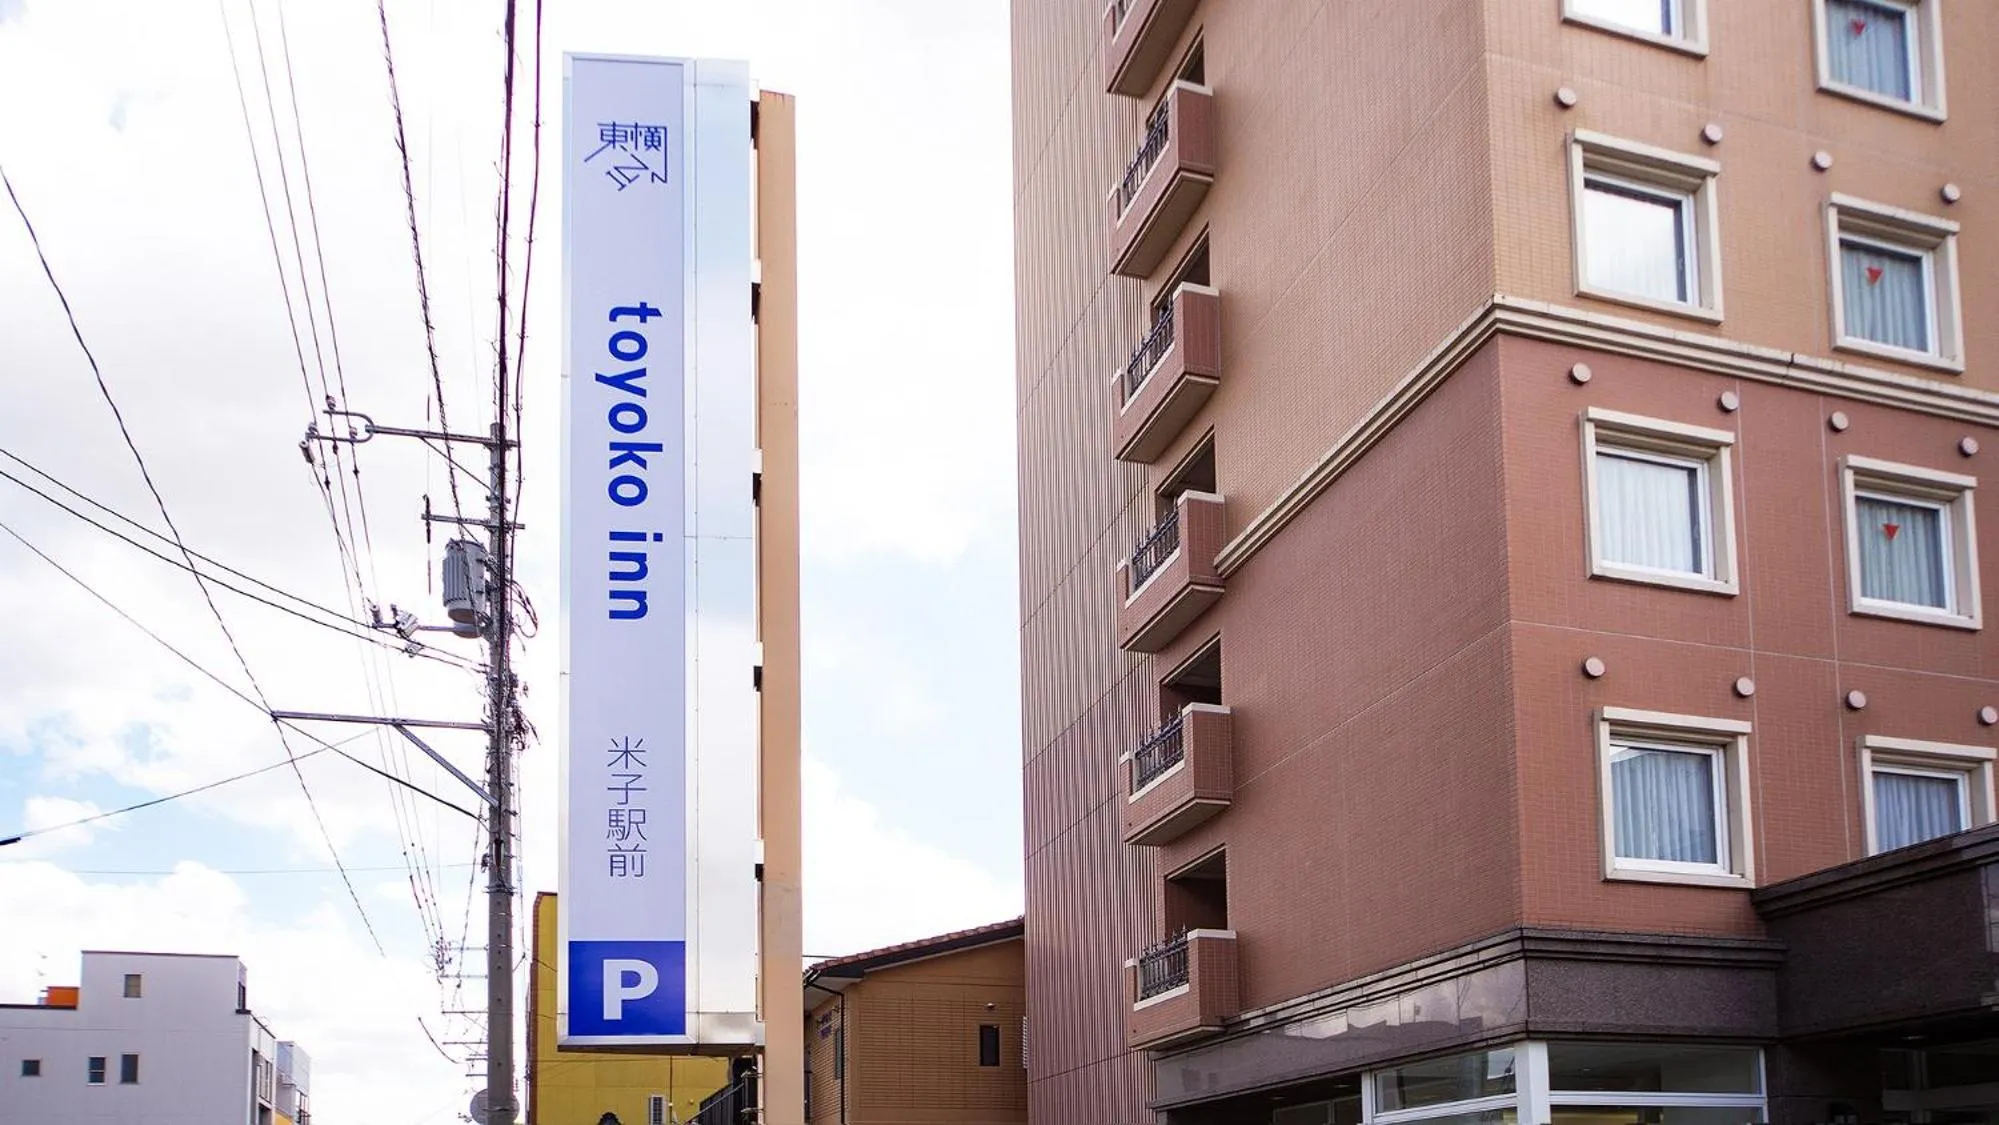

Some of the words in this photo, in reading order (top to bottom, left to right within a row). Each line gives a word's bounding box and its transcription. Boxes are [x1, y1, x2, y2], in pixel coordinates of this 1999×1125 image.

[594, 301, 663, 508] toyoko
[607, 530, 664, 621] inn
[606, 735, 647, 878] 米子駅前
[602, 958, 660, 1020] P
